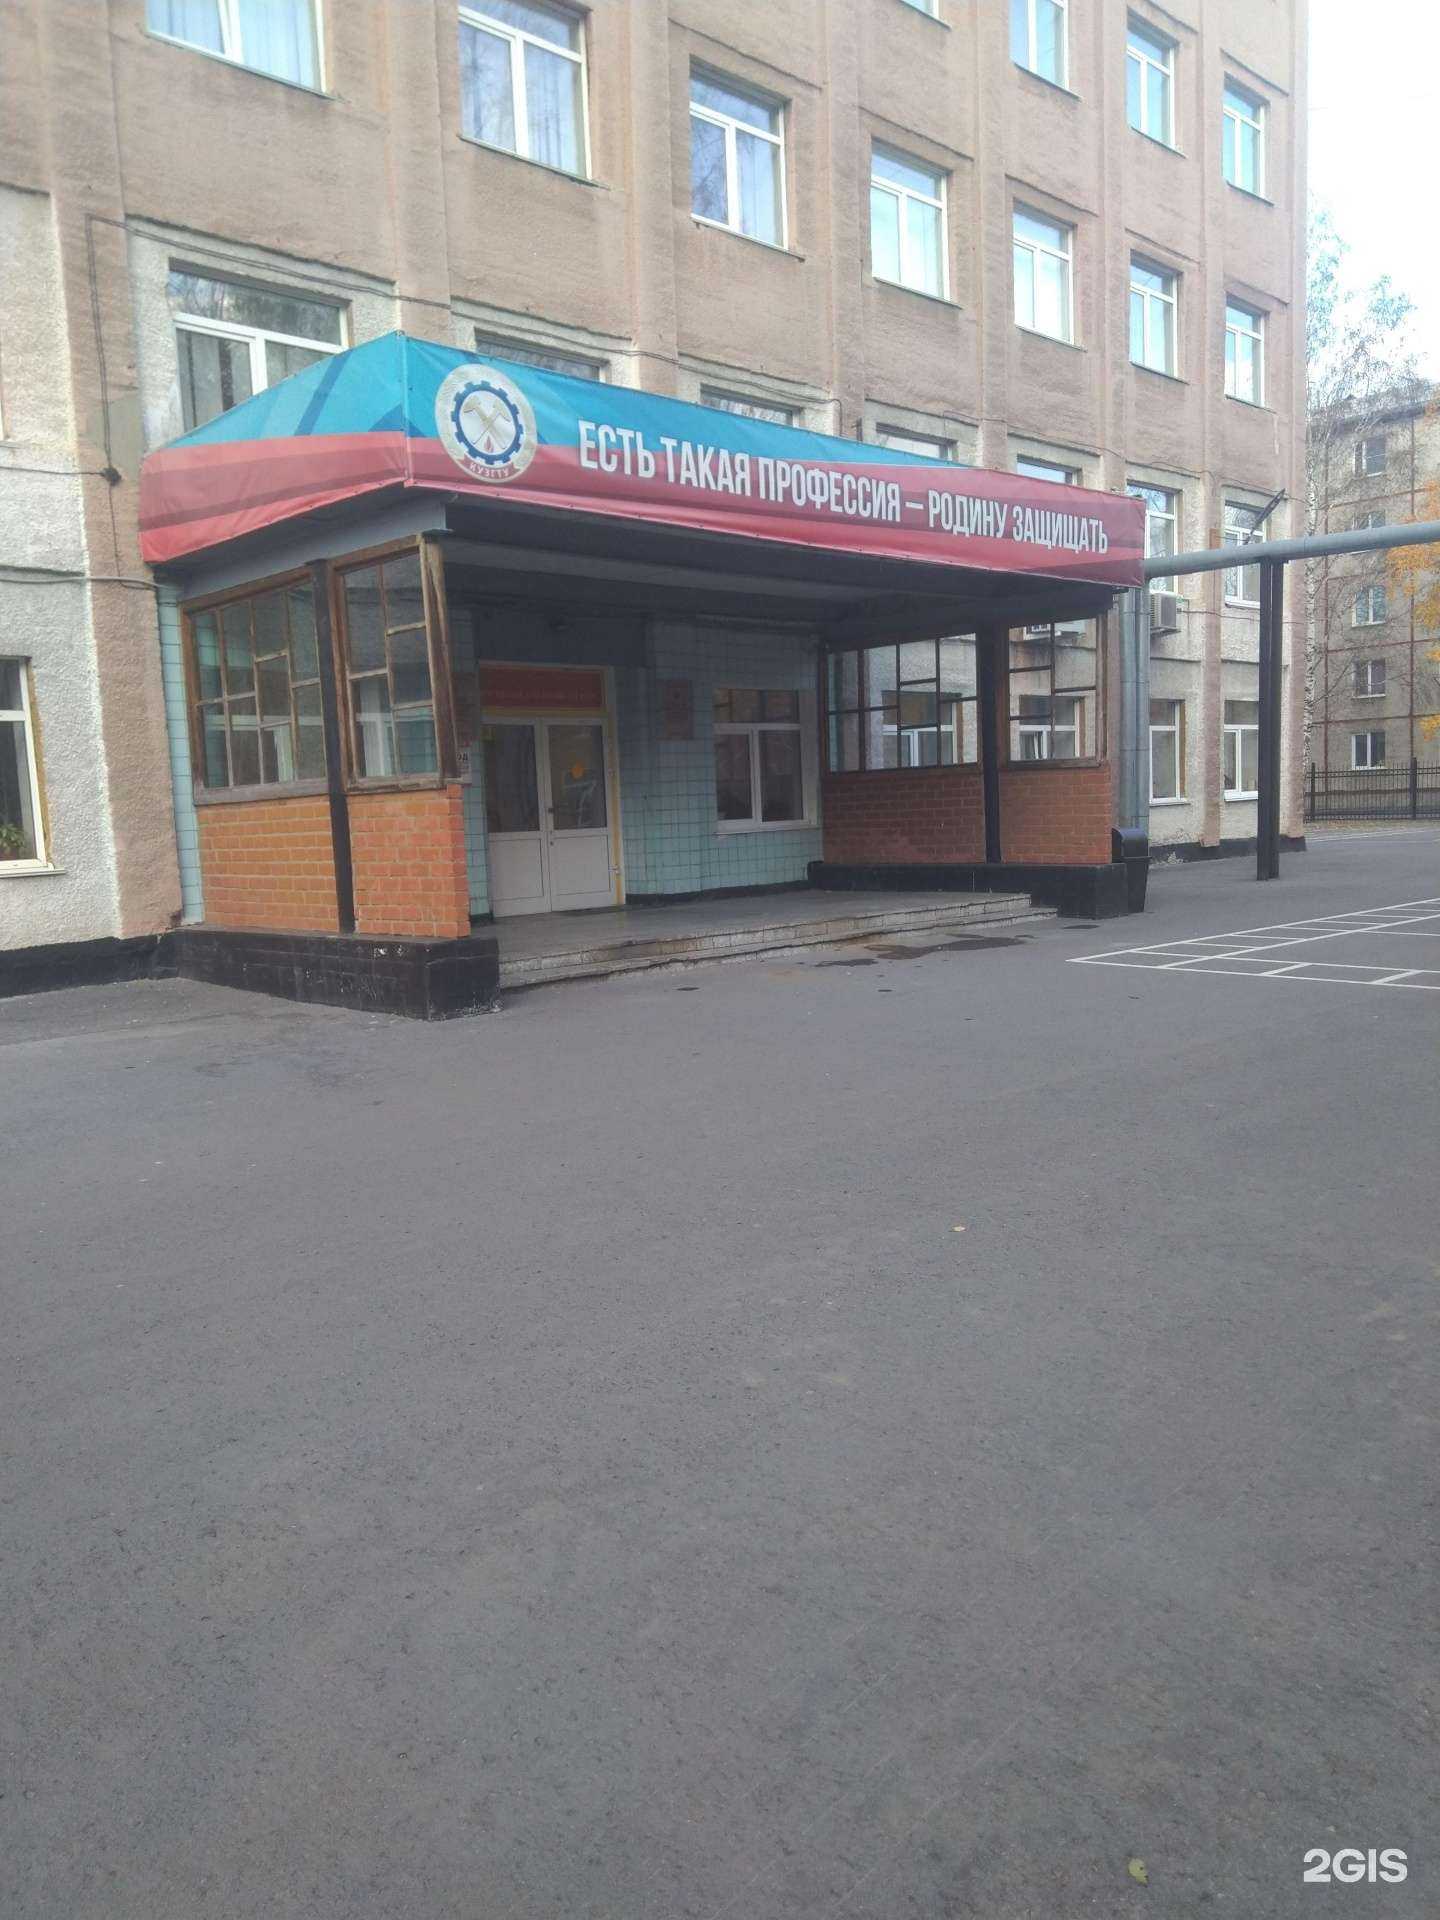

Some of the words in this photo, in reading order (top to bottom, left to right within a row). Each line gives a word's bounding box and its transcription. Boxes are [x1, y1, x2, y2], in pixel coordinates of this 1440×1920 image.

[578, 419, 656, 479] ЕСТЬ
[660, 436, 751, 497] ТАКАЯ
[758, 456, 901, 523] ПРОФЕССИЯ
[928, 489, 1008, 539] РОДИНУ
[1012, 504, 1108, 555] ЗАЩИЩАТЬ
